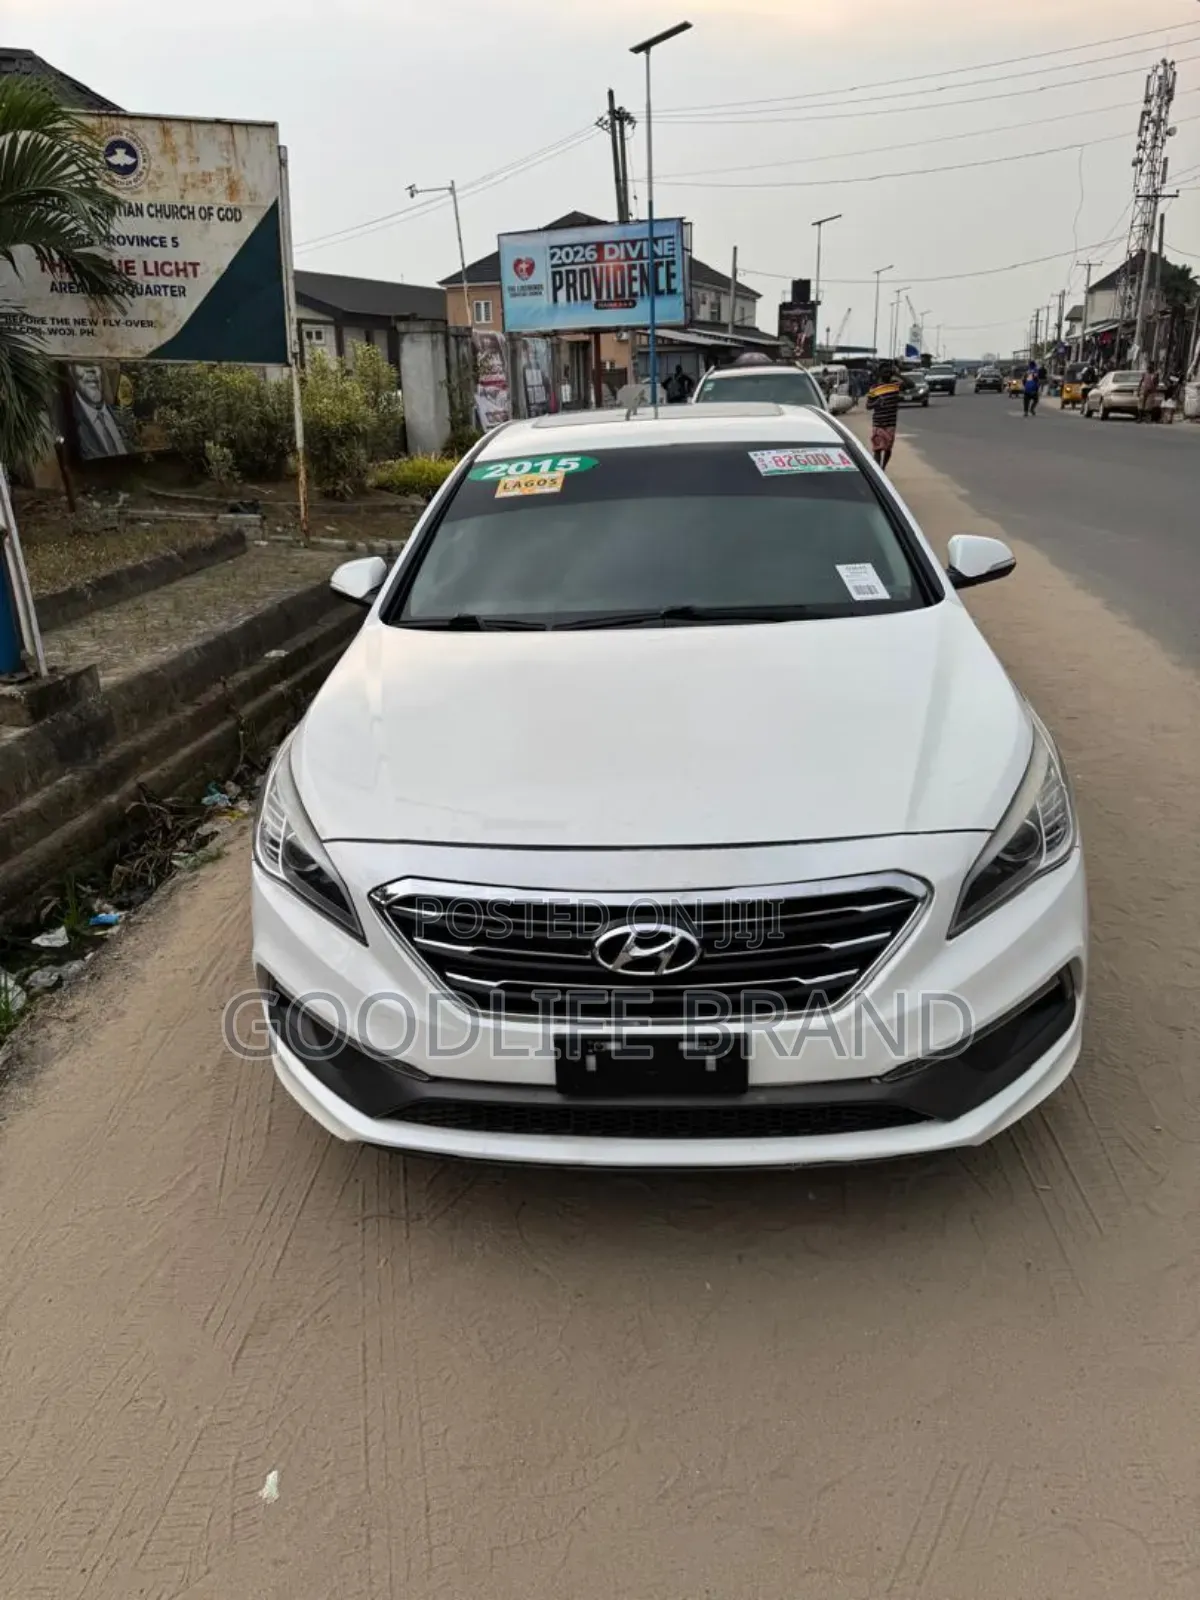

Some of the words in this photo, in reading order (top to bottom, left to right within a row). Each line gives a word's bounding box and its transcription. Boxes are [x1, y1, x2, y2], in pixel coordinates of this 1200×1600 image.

[146, 203, 196, 221] CHURCH
[198, 205, 214, 221] OF
[217, 206, 243, 223] GOD
[171, 235, 180, 248] 5
[550, 245, 597, 264] 2026
[603, 238, 675, 262] DIVINE
[143, 260, 201, 278] LIGHT
[551, 262, 677, 304] PROVIDENCE
[49, 316, 71, 326] THE
[73, 317, 99, 327] NEW
[482, 457, 582, 480] 2015
[502, 478, 558, 490] LAGOS
